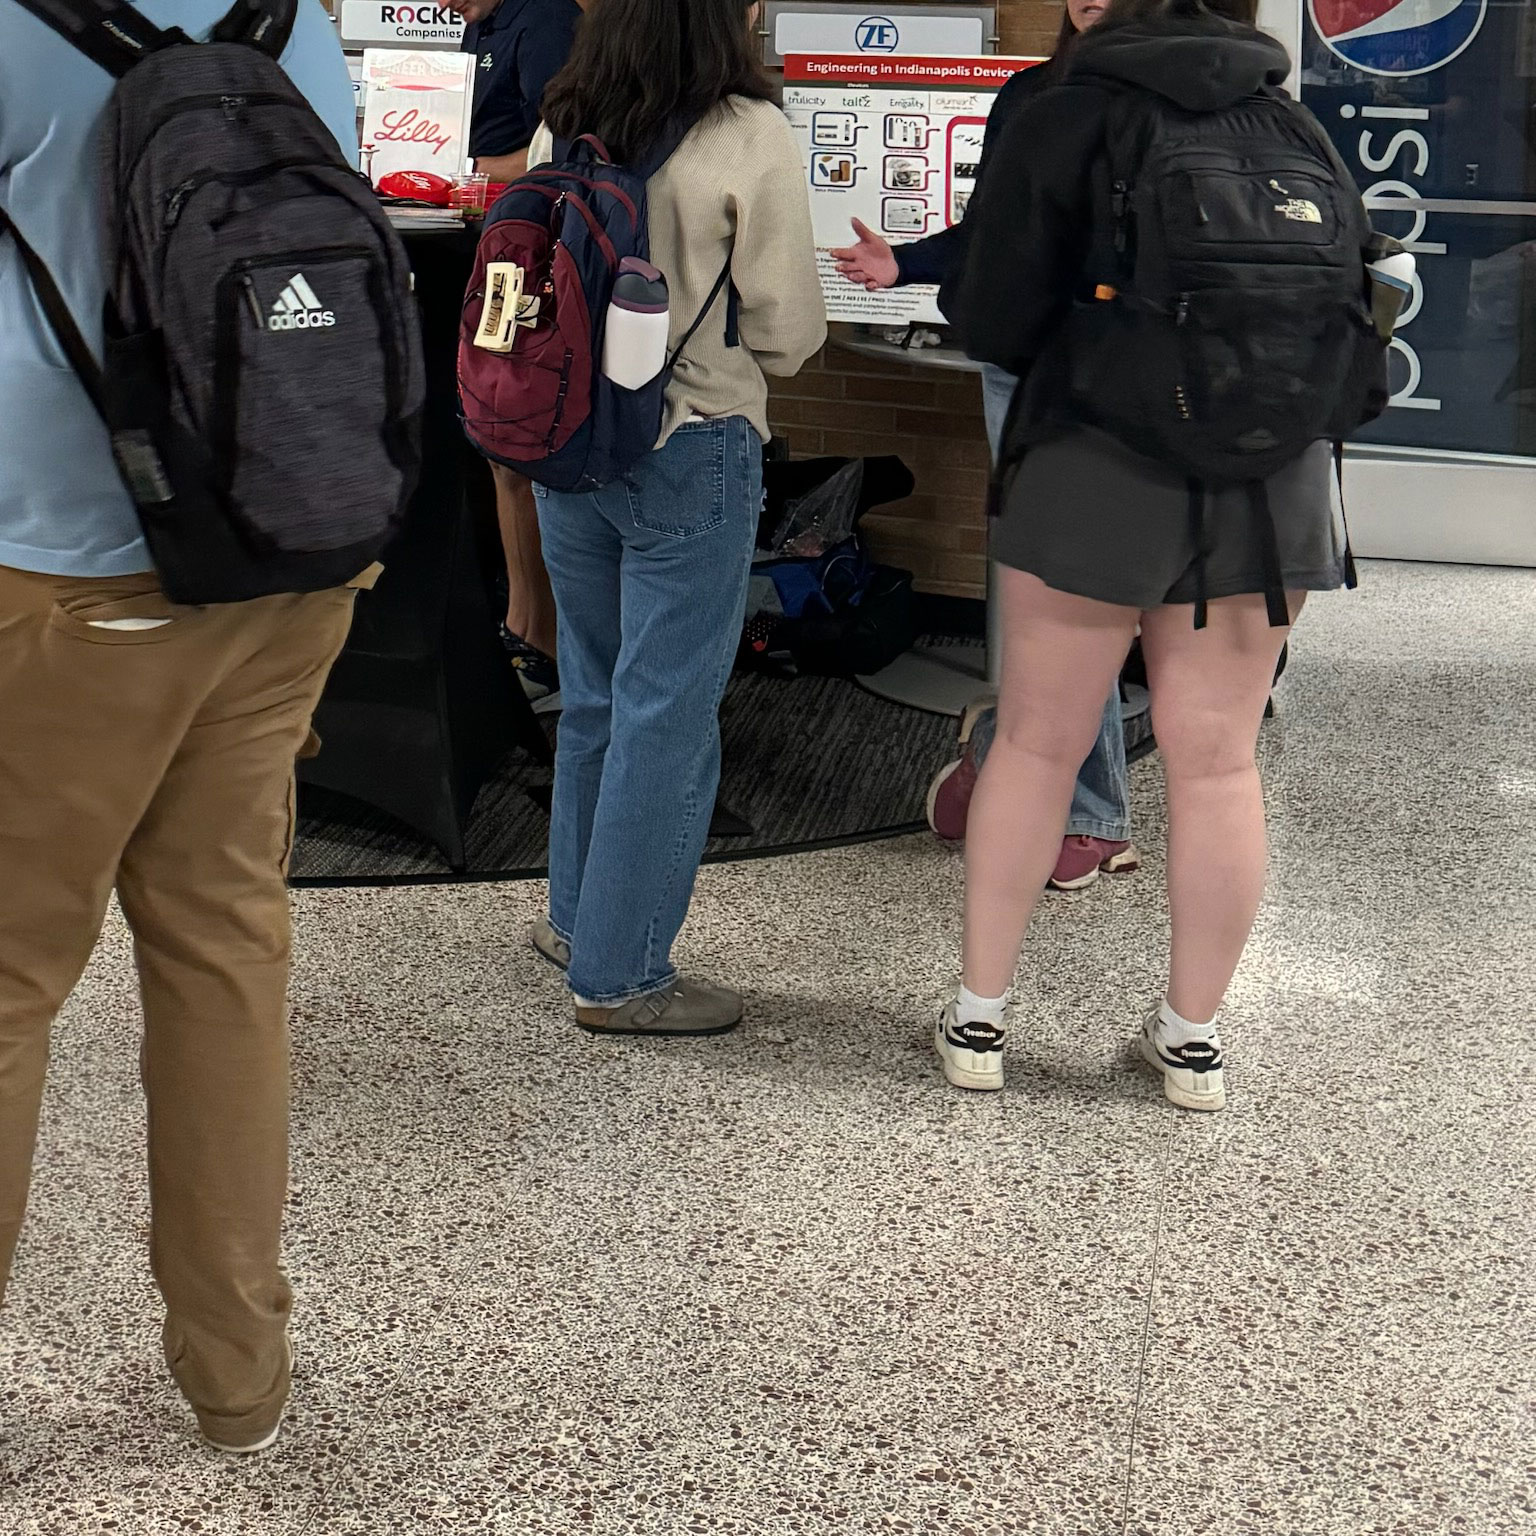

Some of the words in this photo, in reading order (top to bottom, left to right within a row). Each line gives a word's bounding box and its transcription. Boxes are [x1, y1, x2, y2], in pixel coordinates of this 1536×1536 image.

[396, 27, 462, 39] Companies
[861, 25, 895, 48] ZF
[806, 62, 877, 75] Engineering
[880, 64, 892, 74] in
[895, 64, 970, 78] Indianapolis
[373, 109, 452, 155] Lilly
[268, 309, 336, 331] adidas
